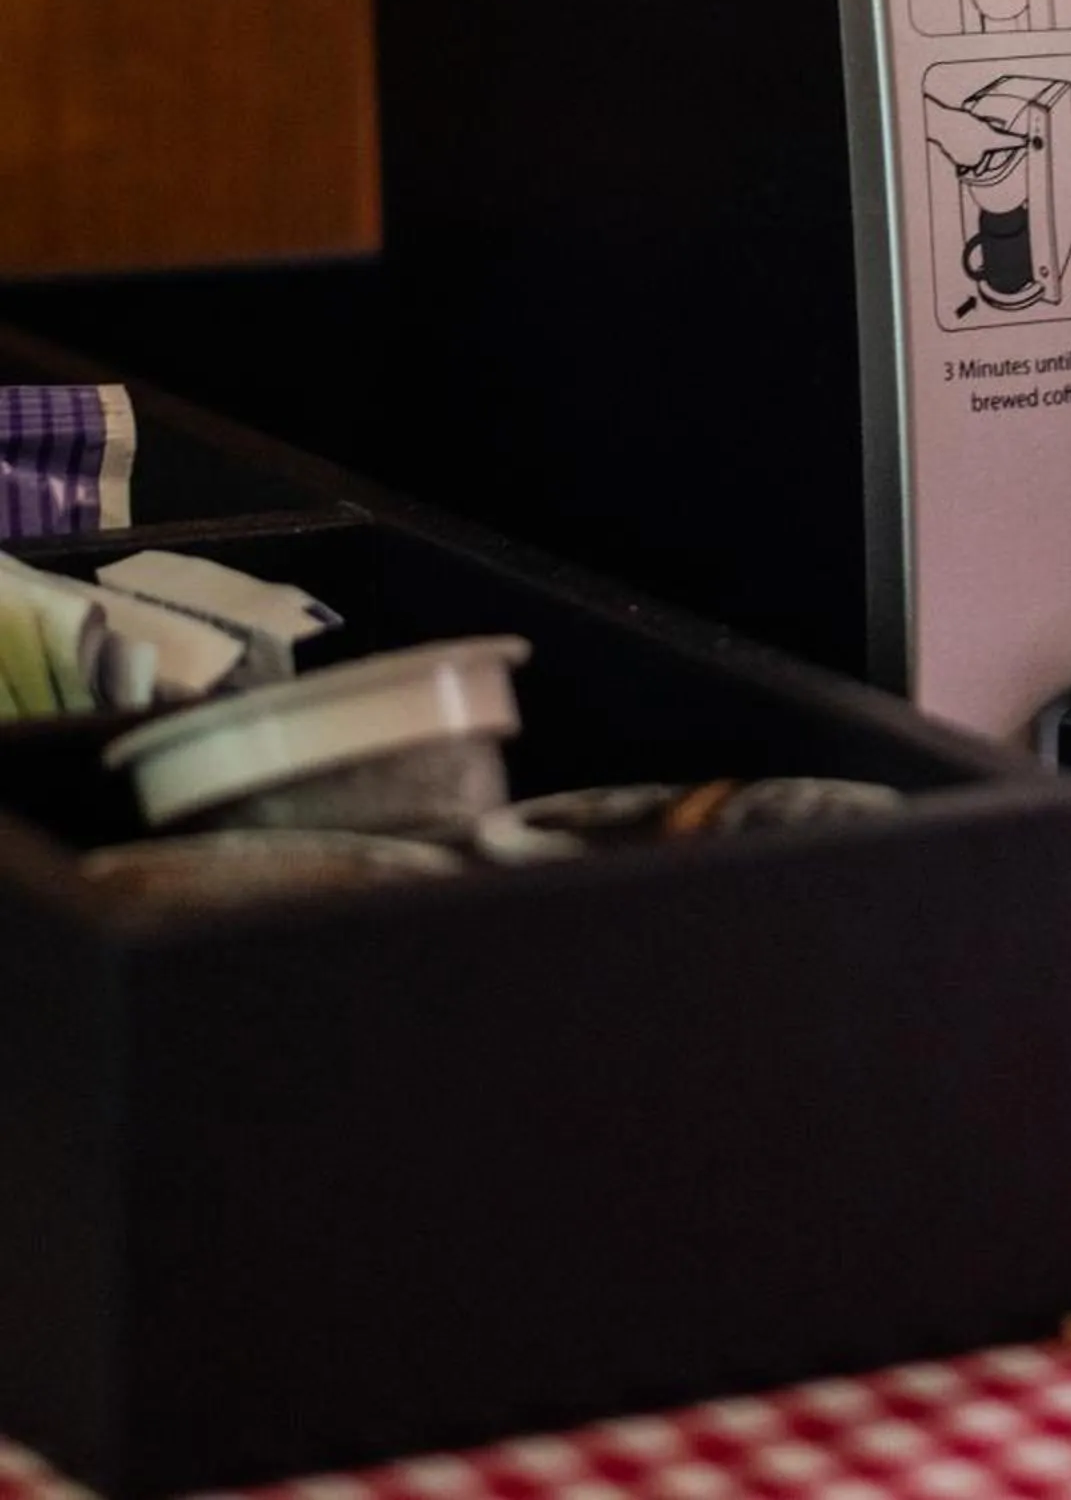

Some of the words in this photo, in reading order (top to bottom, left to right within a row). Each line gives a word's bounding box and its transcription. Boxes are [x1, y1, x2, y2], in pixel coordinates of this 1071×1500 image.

[943, 361, 955, 381] 3
[958, 358, 1031, 380] Minutes
[971, 386, 1038, 412] brewed
